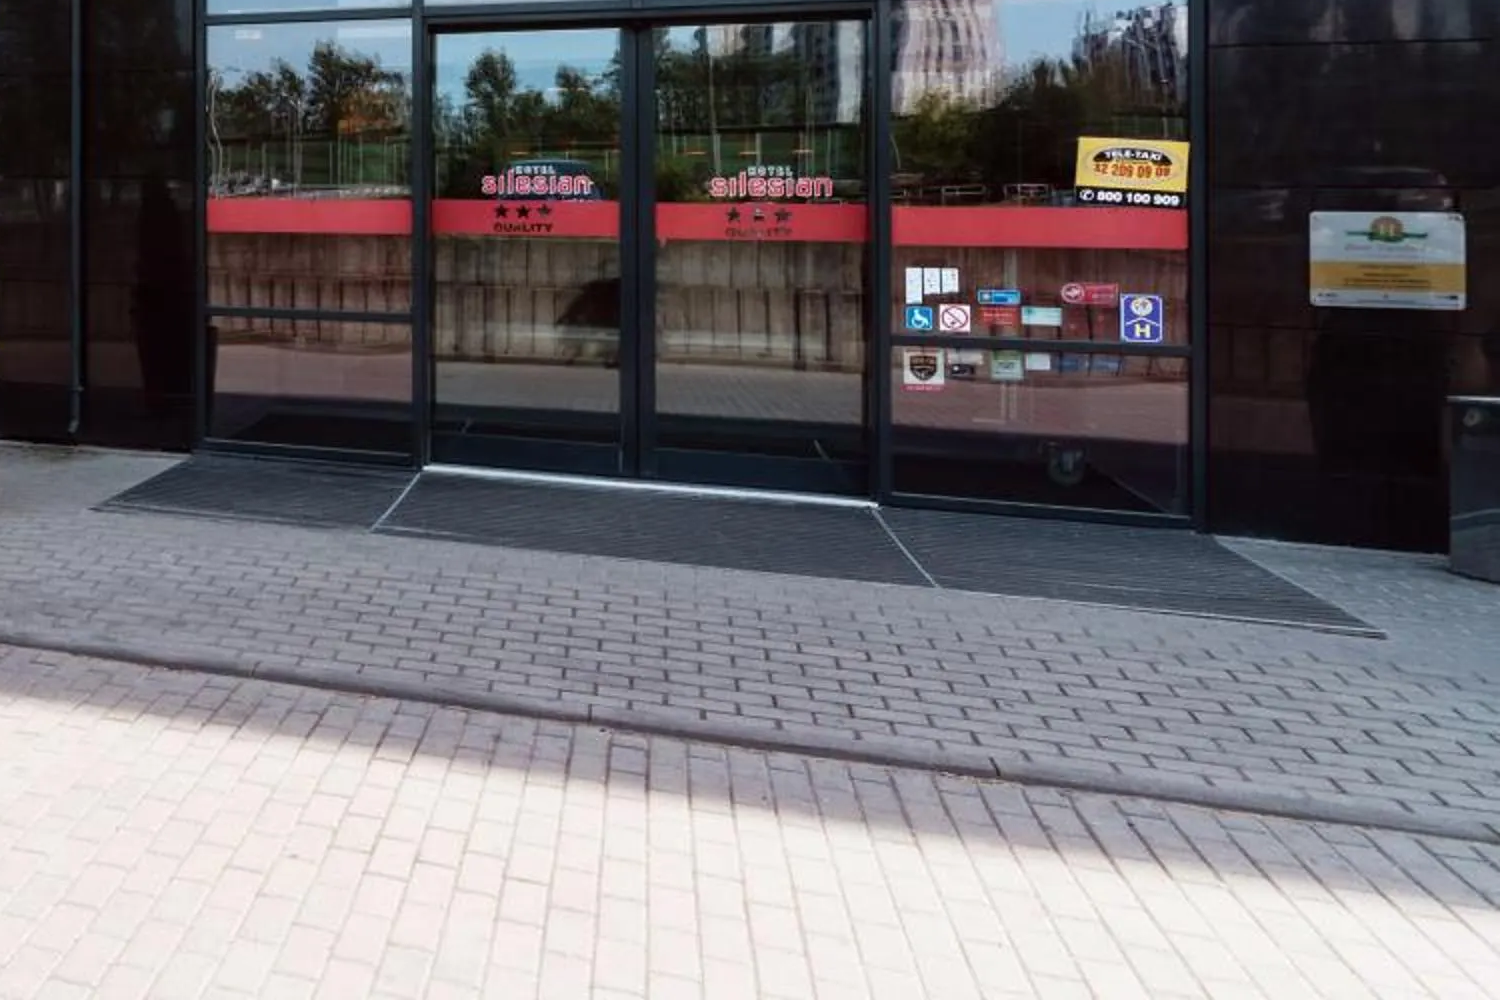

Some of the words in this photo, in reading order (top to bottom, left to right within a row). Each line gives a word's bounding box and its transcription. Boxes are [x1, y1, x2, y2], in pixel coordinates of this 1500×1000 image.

[1097, 190, 1122, 202] 800
[1126, 192, 1151, 203] 100
[1153, 194, 1180, 206] 909
[1134, 323, 1152, 339] H
